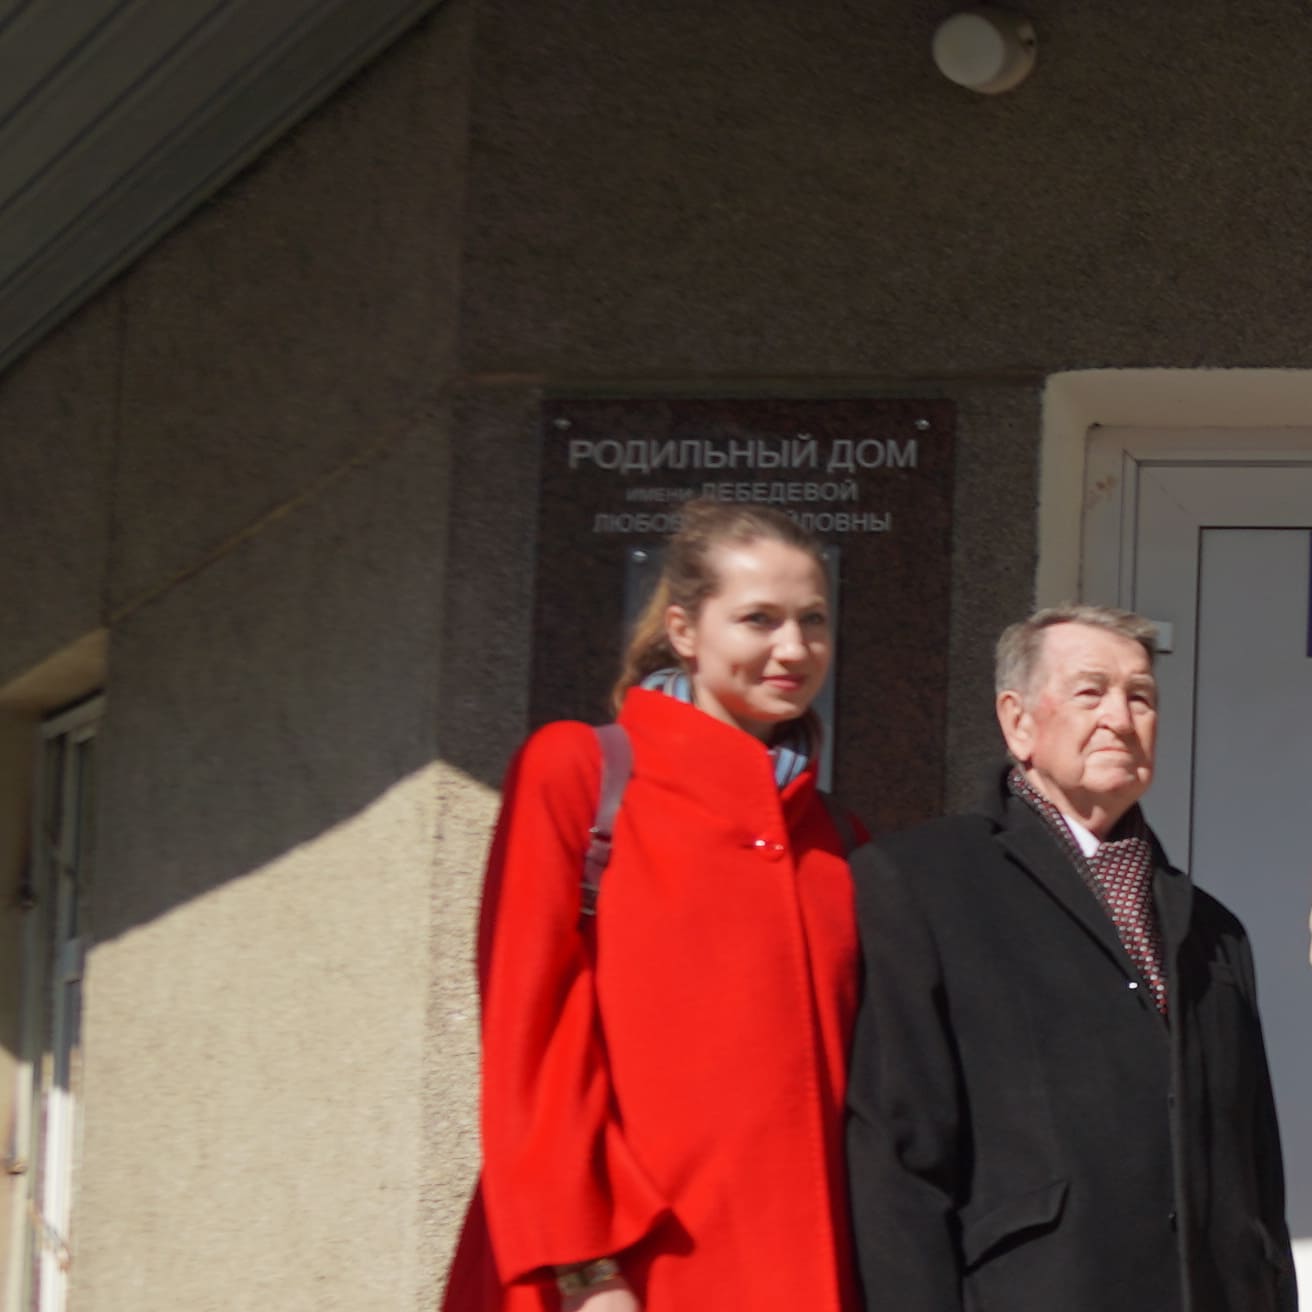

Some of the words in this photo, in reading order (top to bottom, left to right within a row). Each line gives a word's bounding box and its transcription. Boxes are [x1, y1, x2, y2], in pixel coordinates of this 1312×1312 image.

[568, 433, 818, 474] РОДИЛЬНЫЙ
[826, 439, 918, 474] ДОМ
[592, 512, 683, 533] ЛЮБОВ
